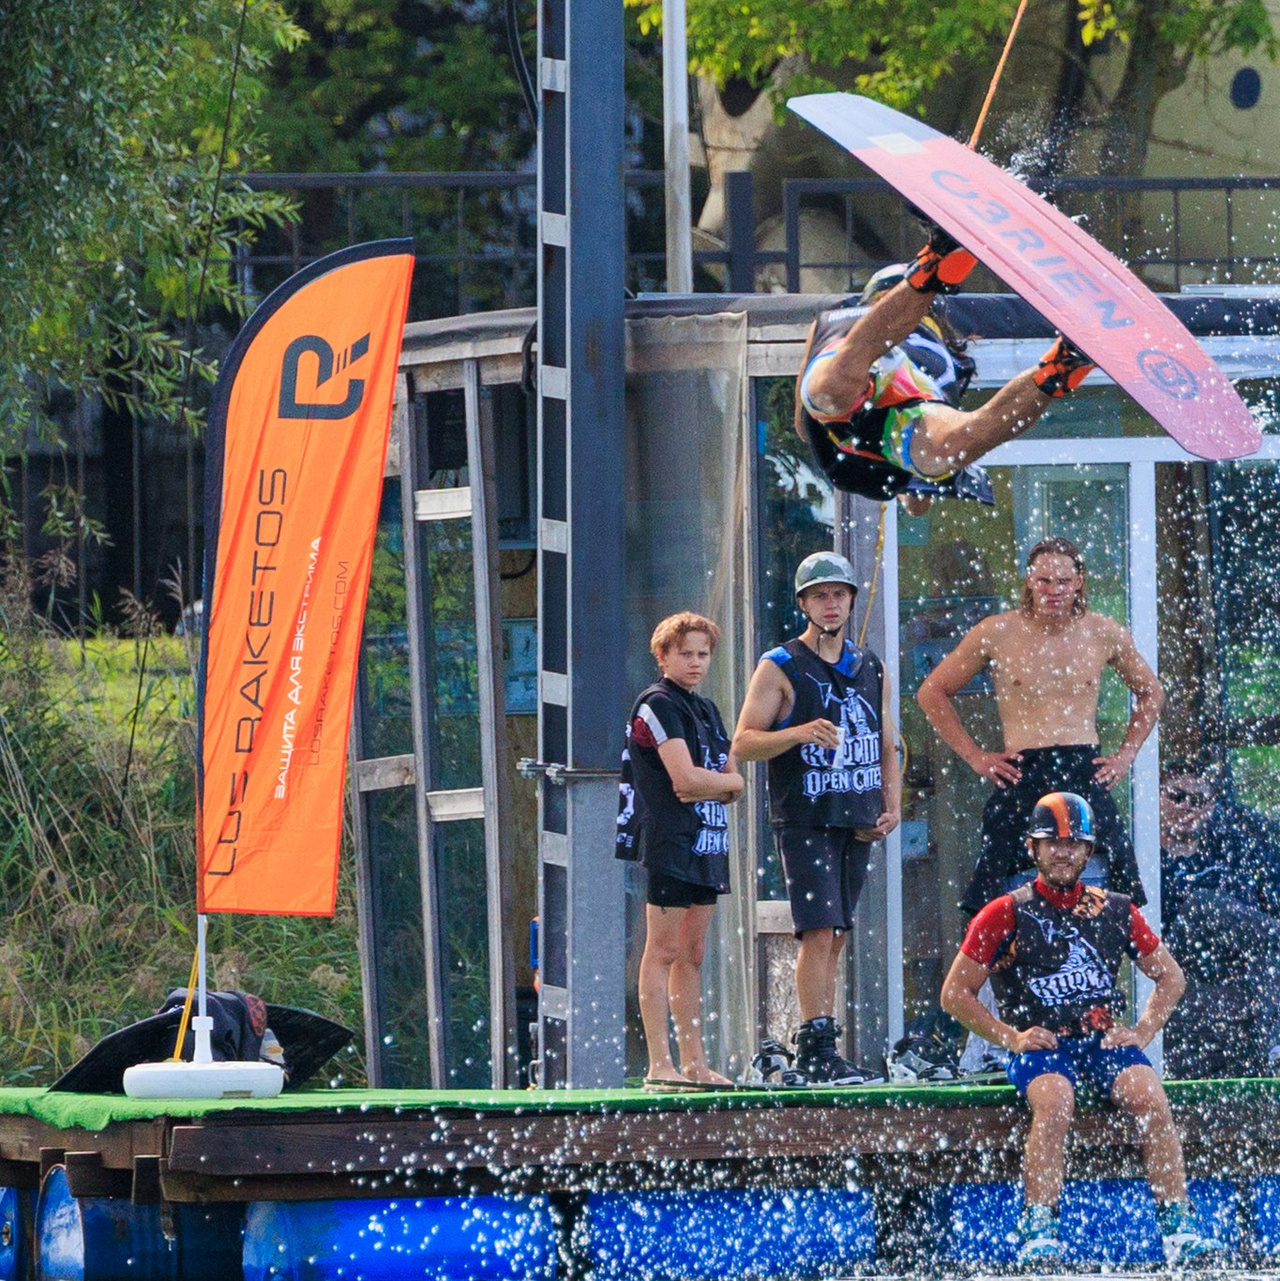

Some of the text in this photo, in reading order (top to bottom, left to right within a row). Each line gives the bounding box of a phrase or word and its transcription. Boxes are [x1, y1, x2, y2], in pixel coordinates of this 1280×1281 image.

[208, 468, 288, 877] LOS RAKETOS
[274, 536, 322, 800] ЗАЩИТА ДЛЯ ЭКСТРИМА
[309, 561, 349, 767] LOSRAKETOS.COM
[803, 770, 851, 797] OPEN
